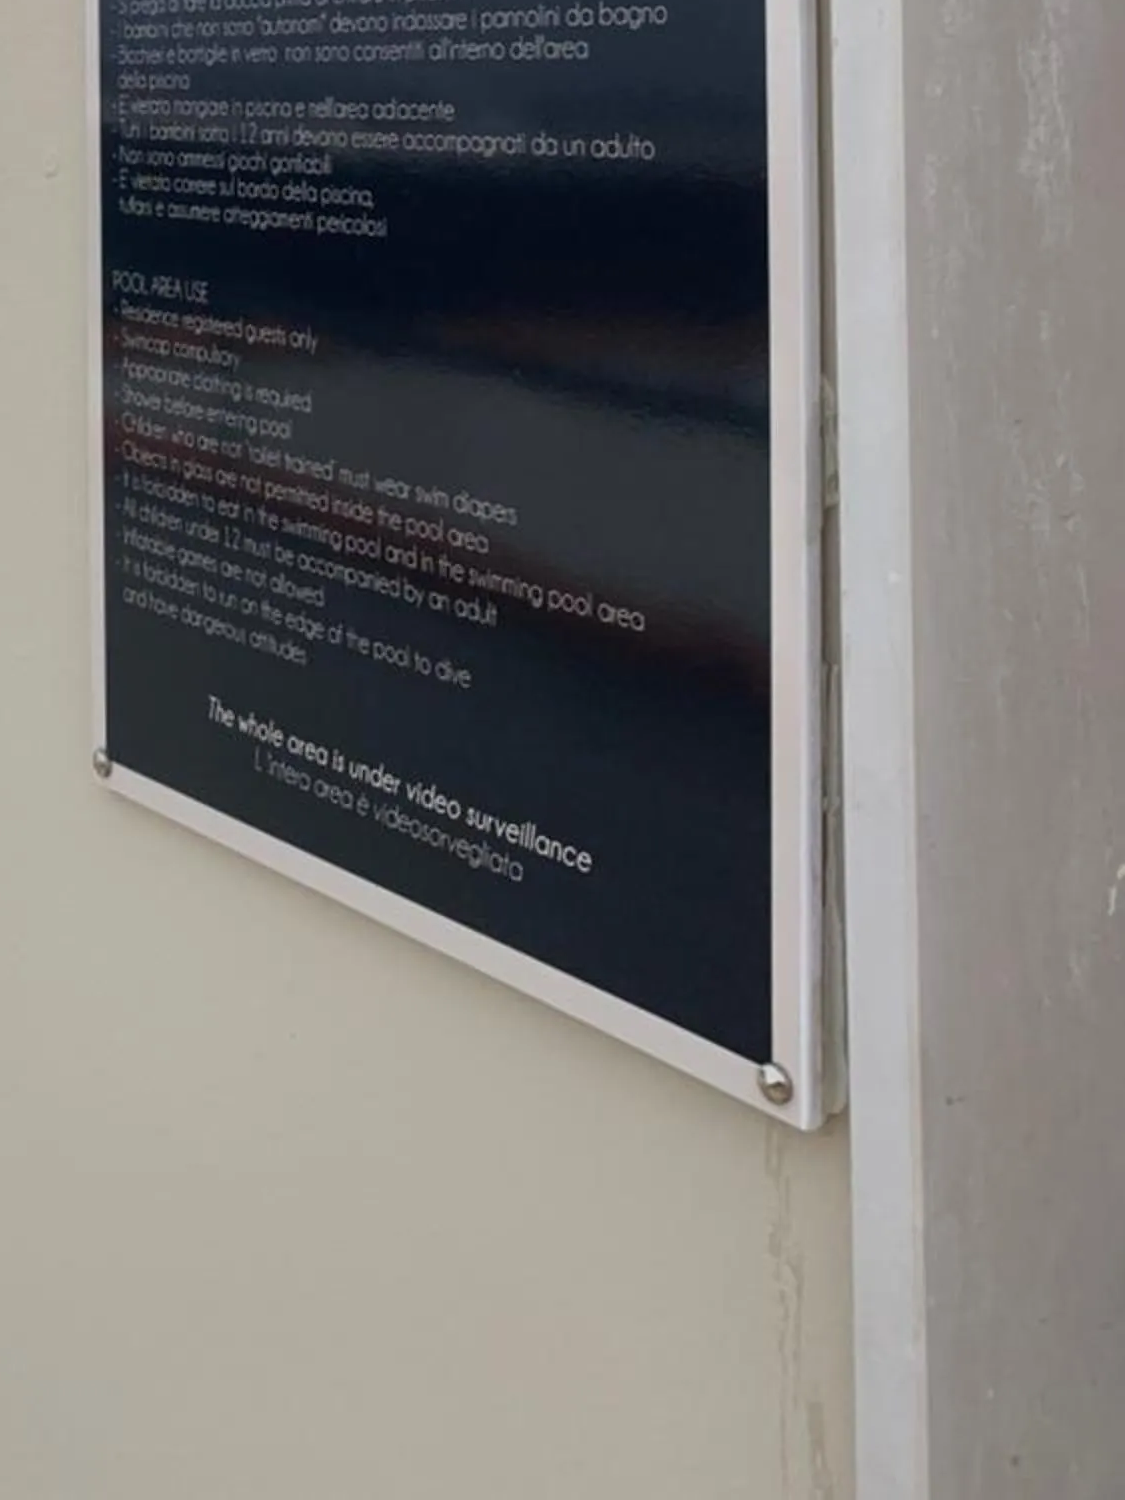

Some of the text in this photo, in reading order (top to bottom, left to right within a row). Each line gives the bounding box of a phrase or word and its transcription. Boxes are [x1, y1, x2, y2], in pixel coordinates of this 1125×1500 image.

[392, 10, 467, 31] indossare
[479, 5, 560, 32] pannolini
[564, 3, 593, 27] da
[598, 2, 667, 29] bagno
[530, 132, 558, 155] da
[562, 138, 585, 156] un
[589, 134, 655, 159] adulto
[414, 484, 449, 510] swim
[452, 488, 518, 526] diapers
[447, 527, 488, 554] area
[420, 550, 433, 574] in
[438, 554, 464, 583] the
[468, 566, 542, 608] swimming
[547, 588, 592, 618] pool
[597, 601, 645, 633] area
[428, 590, 450, 614] an
[454, 596, 498, 628] adult
[434, 654, 472, 690] dive
[208, 696, 592, 875] The whole area is under video surveillance
[313, 777, 353, 811] area
